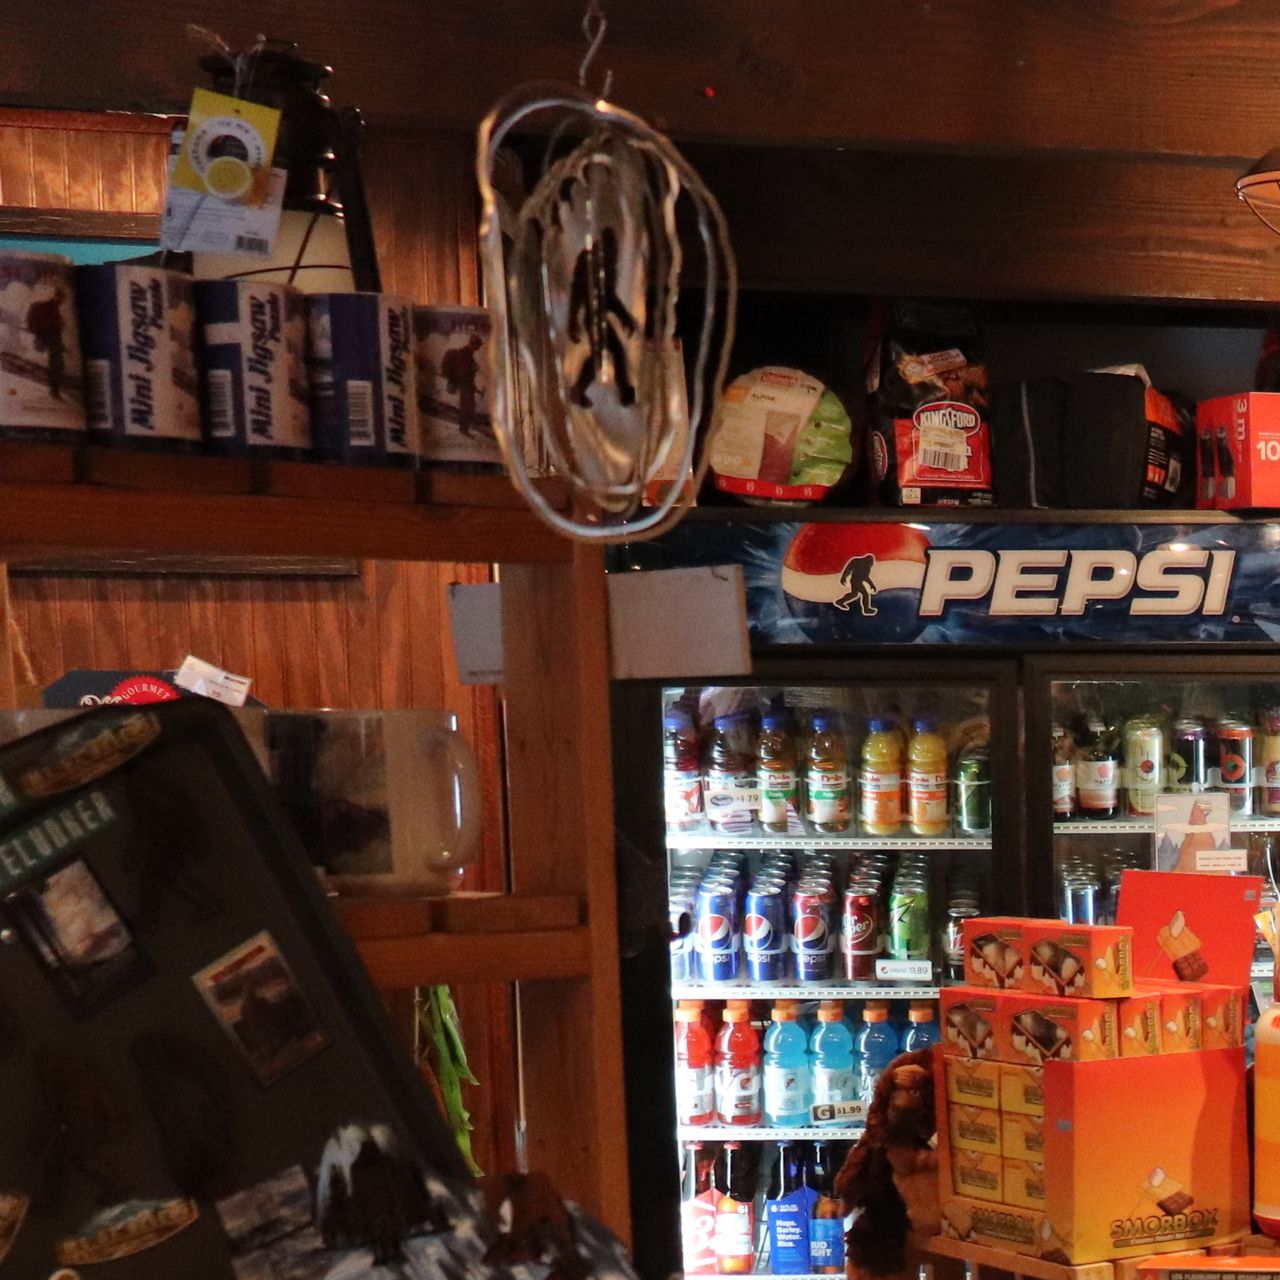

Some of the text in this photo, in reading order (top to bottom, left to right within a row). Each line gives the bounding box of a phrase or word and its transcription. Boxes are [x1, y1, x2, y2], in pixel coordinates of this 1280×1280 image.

[128, 281, 156, 430] Mini Jigsaw
[248, 296, 276, 439] Mini Jigsaw
[920, 409, 976, 429] KINGSFORD
[1256, 441, 1280, 461] 10
[917, 547, 1234, 618] PEPSI
[837, 1105, 862, 1115] $1.99
[1110, 1207, 1219, 1239] SMORBOX
